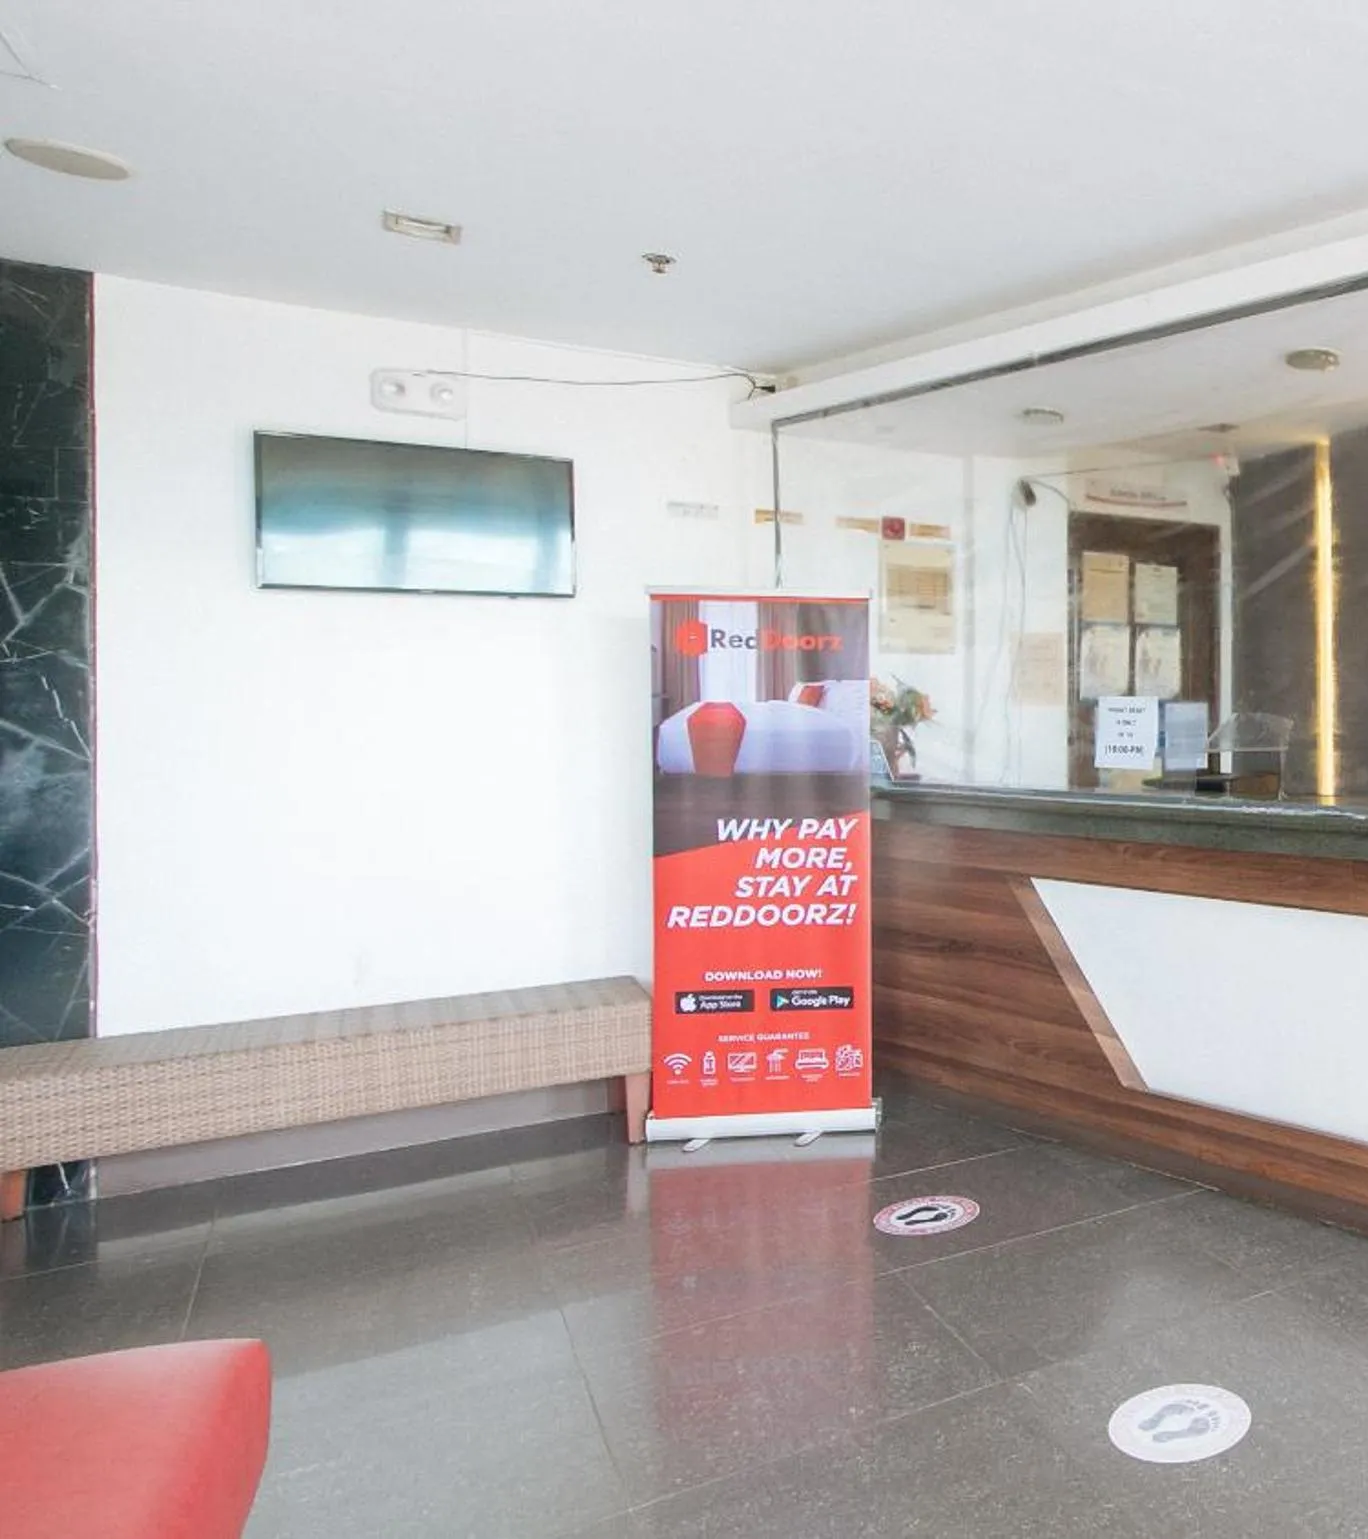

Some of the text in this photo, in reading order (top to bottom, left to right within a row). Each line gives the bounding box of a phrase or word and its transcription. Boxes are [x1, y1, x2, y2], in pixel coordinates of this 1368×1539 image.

[716, 817, 859, 842] WHY PAY
[754, 846, 853, 872] MORE,
[735, 873, 859, 898] STAY AT
[666, 903, 857, 929] REDDOORZ!
[704, 967, 824, 983] DOWNLOAD NOW!
[699, 999, 742, 1010] App Store
[791, 995, 851, 1008] Google Play
[718, 1031, 810, 1044] SERVICE GUARANTEE
